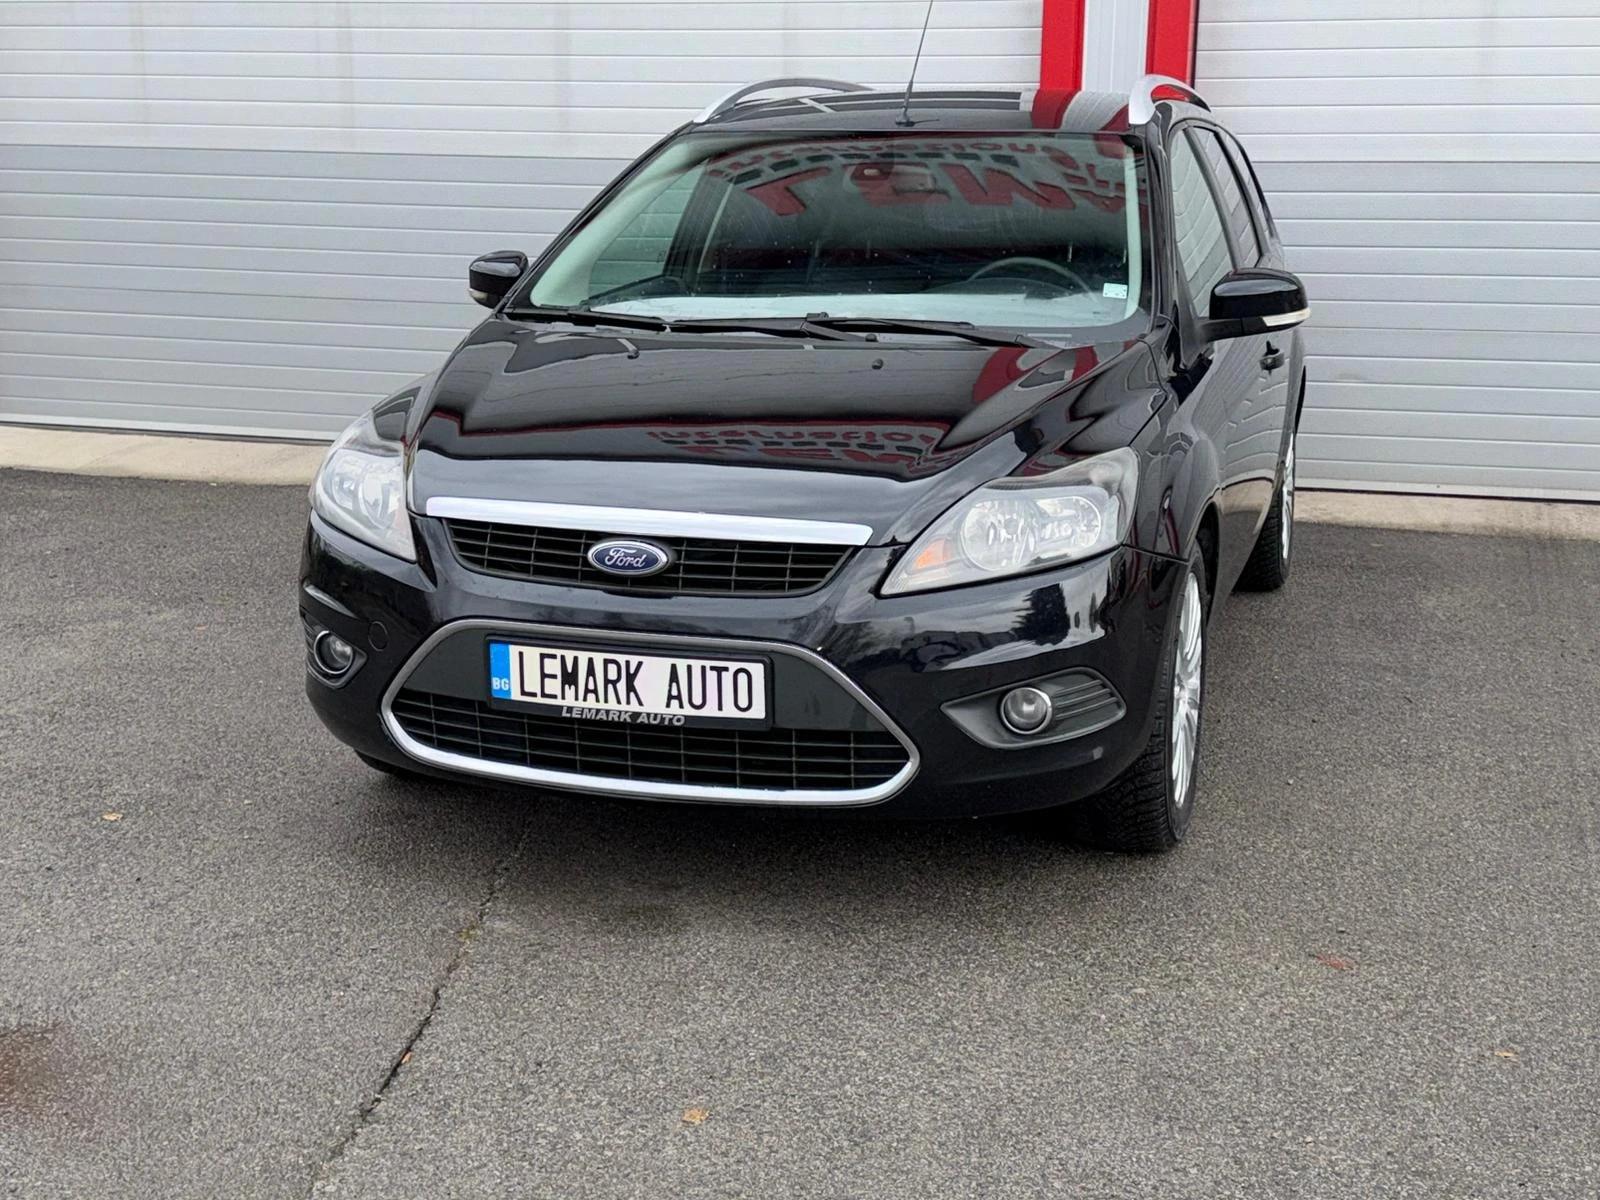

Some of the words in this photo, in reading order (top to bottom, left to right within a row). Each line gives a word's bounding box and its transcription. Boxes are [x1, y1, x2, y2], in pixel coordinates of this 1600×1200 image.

[604, 547, 647, 568] Ford
[492, 676, 510, 691] BG
[518, 651, 644, 707] LEMARK
[665, 663, 753, 712] AUTO
[562, 706, 631, 723] LEMARK
[637, 711, 685, 727] AUTO
